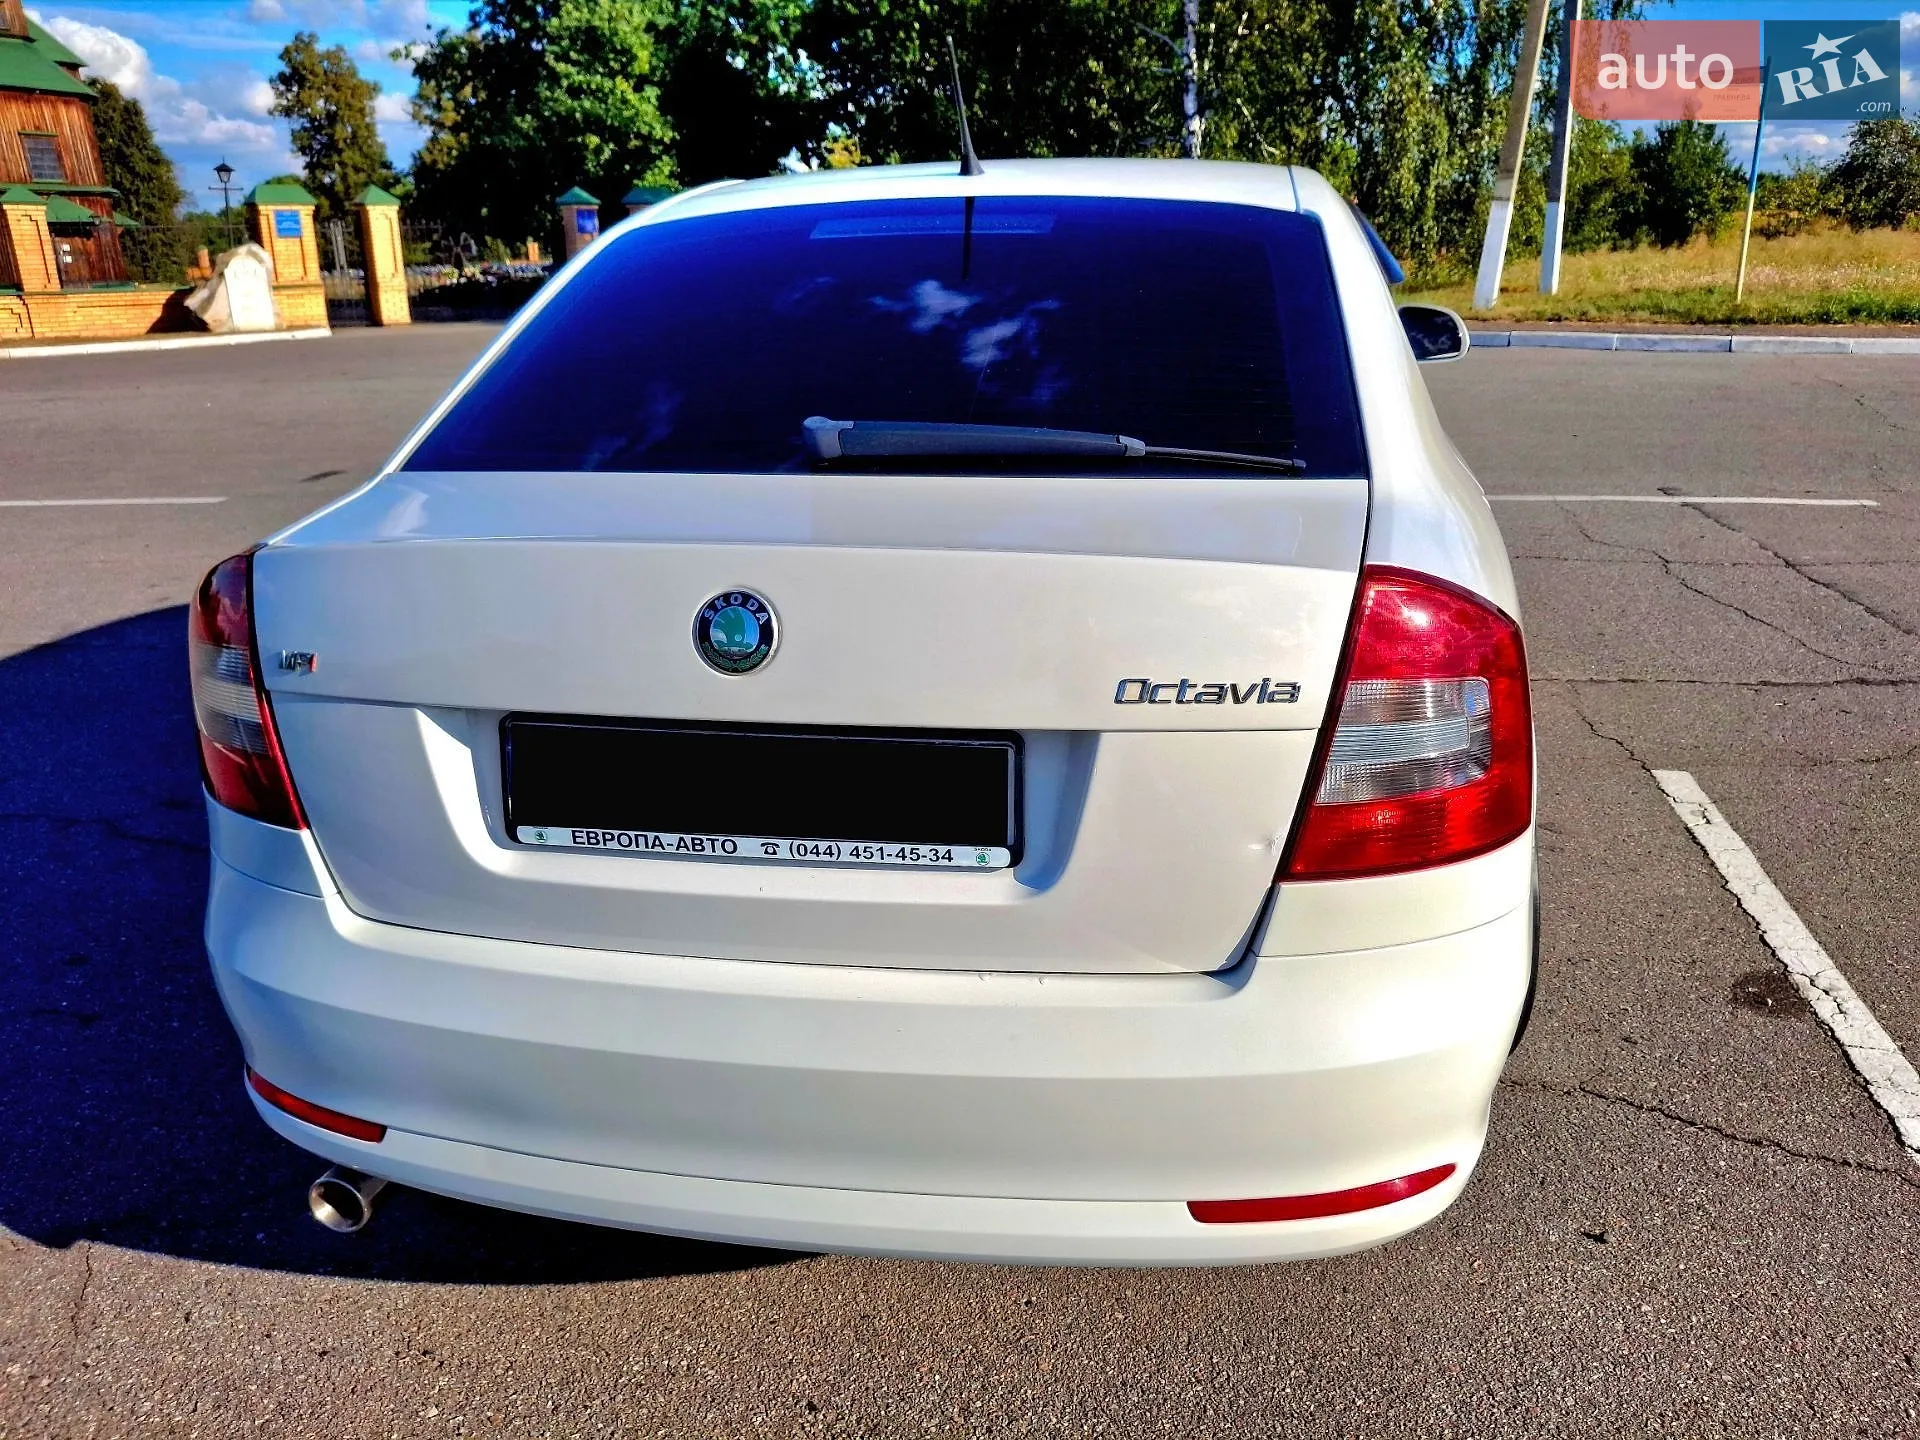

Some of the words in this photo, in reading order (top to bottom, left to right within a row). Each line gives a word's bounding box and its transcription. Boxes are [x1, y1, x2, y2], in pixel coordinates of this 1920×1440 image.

[1113, 677, 1301, 705] Octavia
[571, 829, 738, 855] ЕВРОПА-АВТО
[788, 841, 842, 861] (044)
[849, 845, 954, 863] 451-45-34
